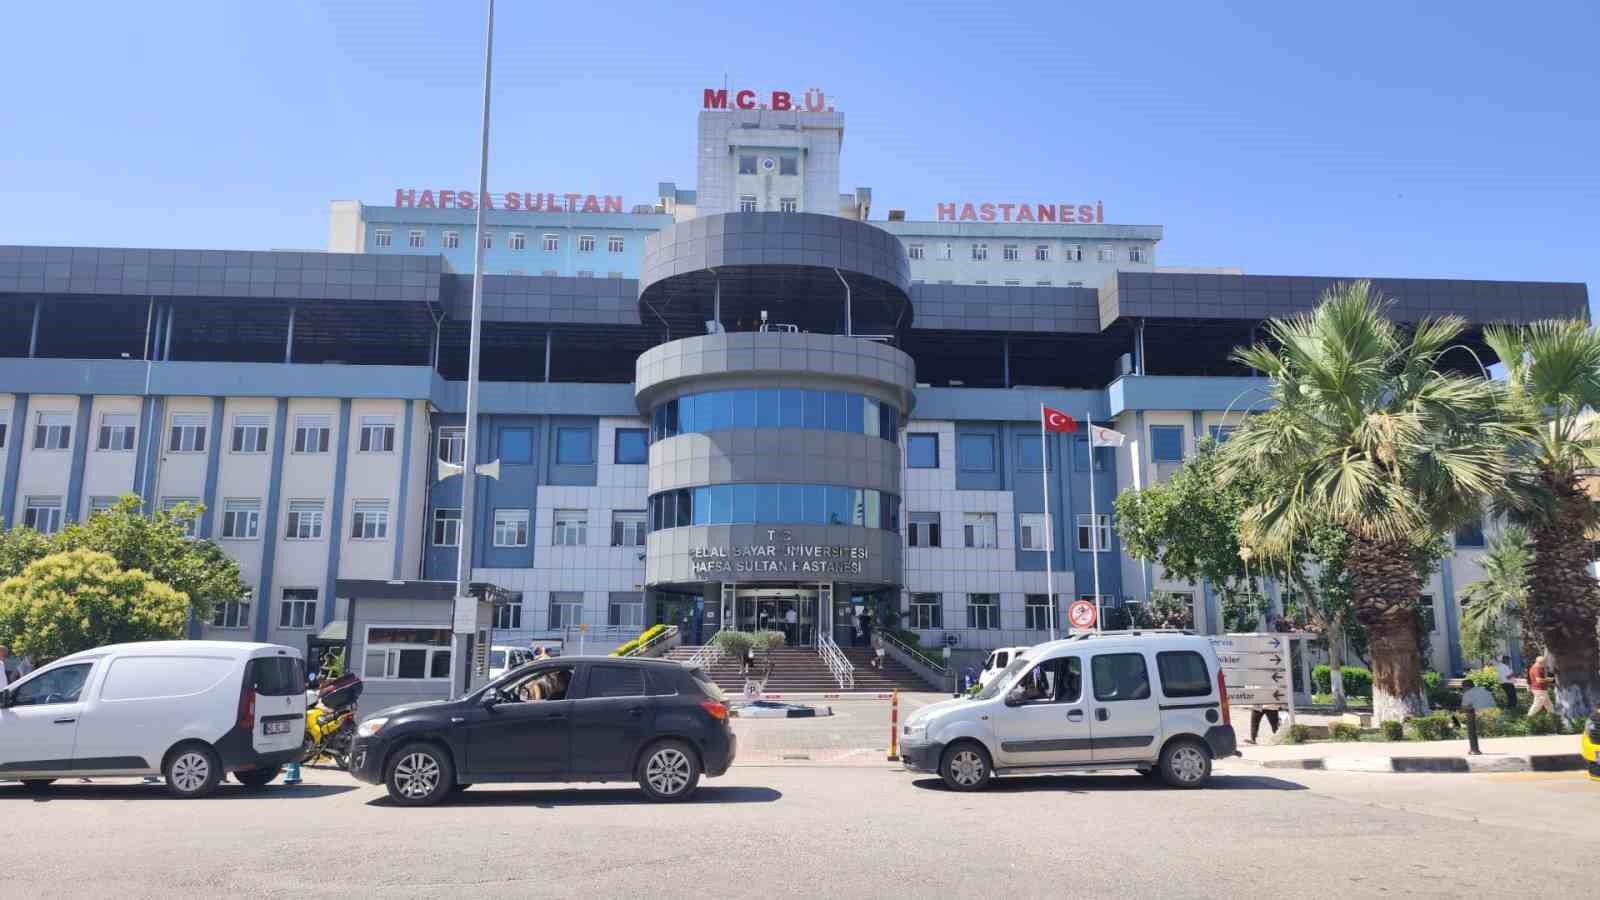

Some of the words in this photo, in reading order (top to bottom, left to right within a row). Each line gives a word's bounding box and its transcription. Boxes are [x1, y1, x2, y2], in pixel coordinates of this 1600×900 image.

[395, 189, 494, 209] HAFSA
[504, 191, 623, 213] SULTAN
[937, 200, 1104, 223] HASTANESİ
[692, 560, 733, 574] HAFSA
[736, 560, 788, 572] SULTAN
